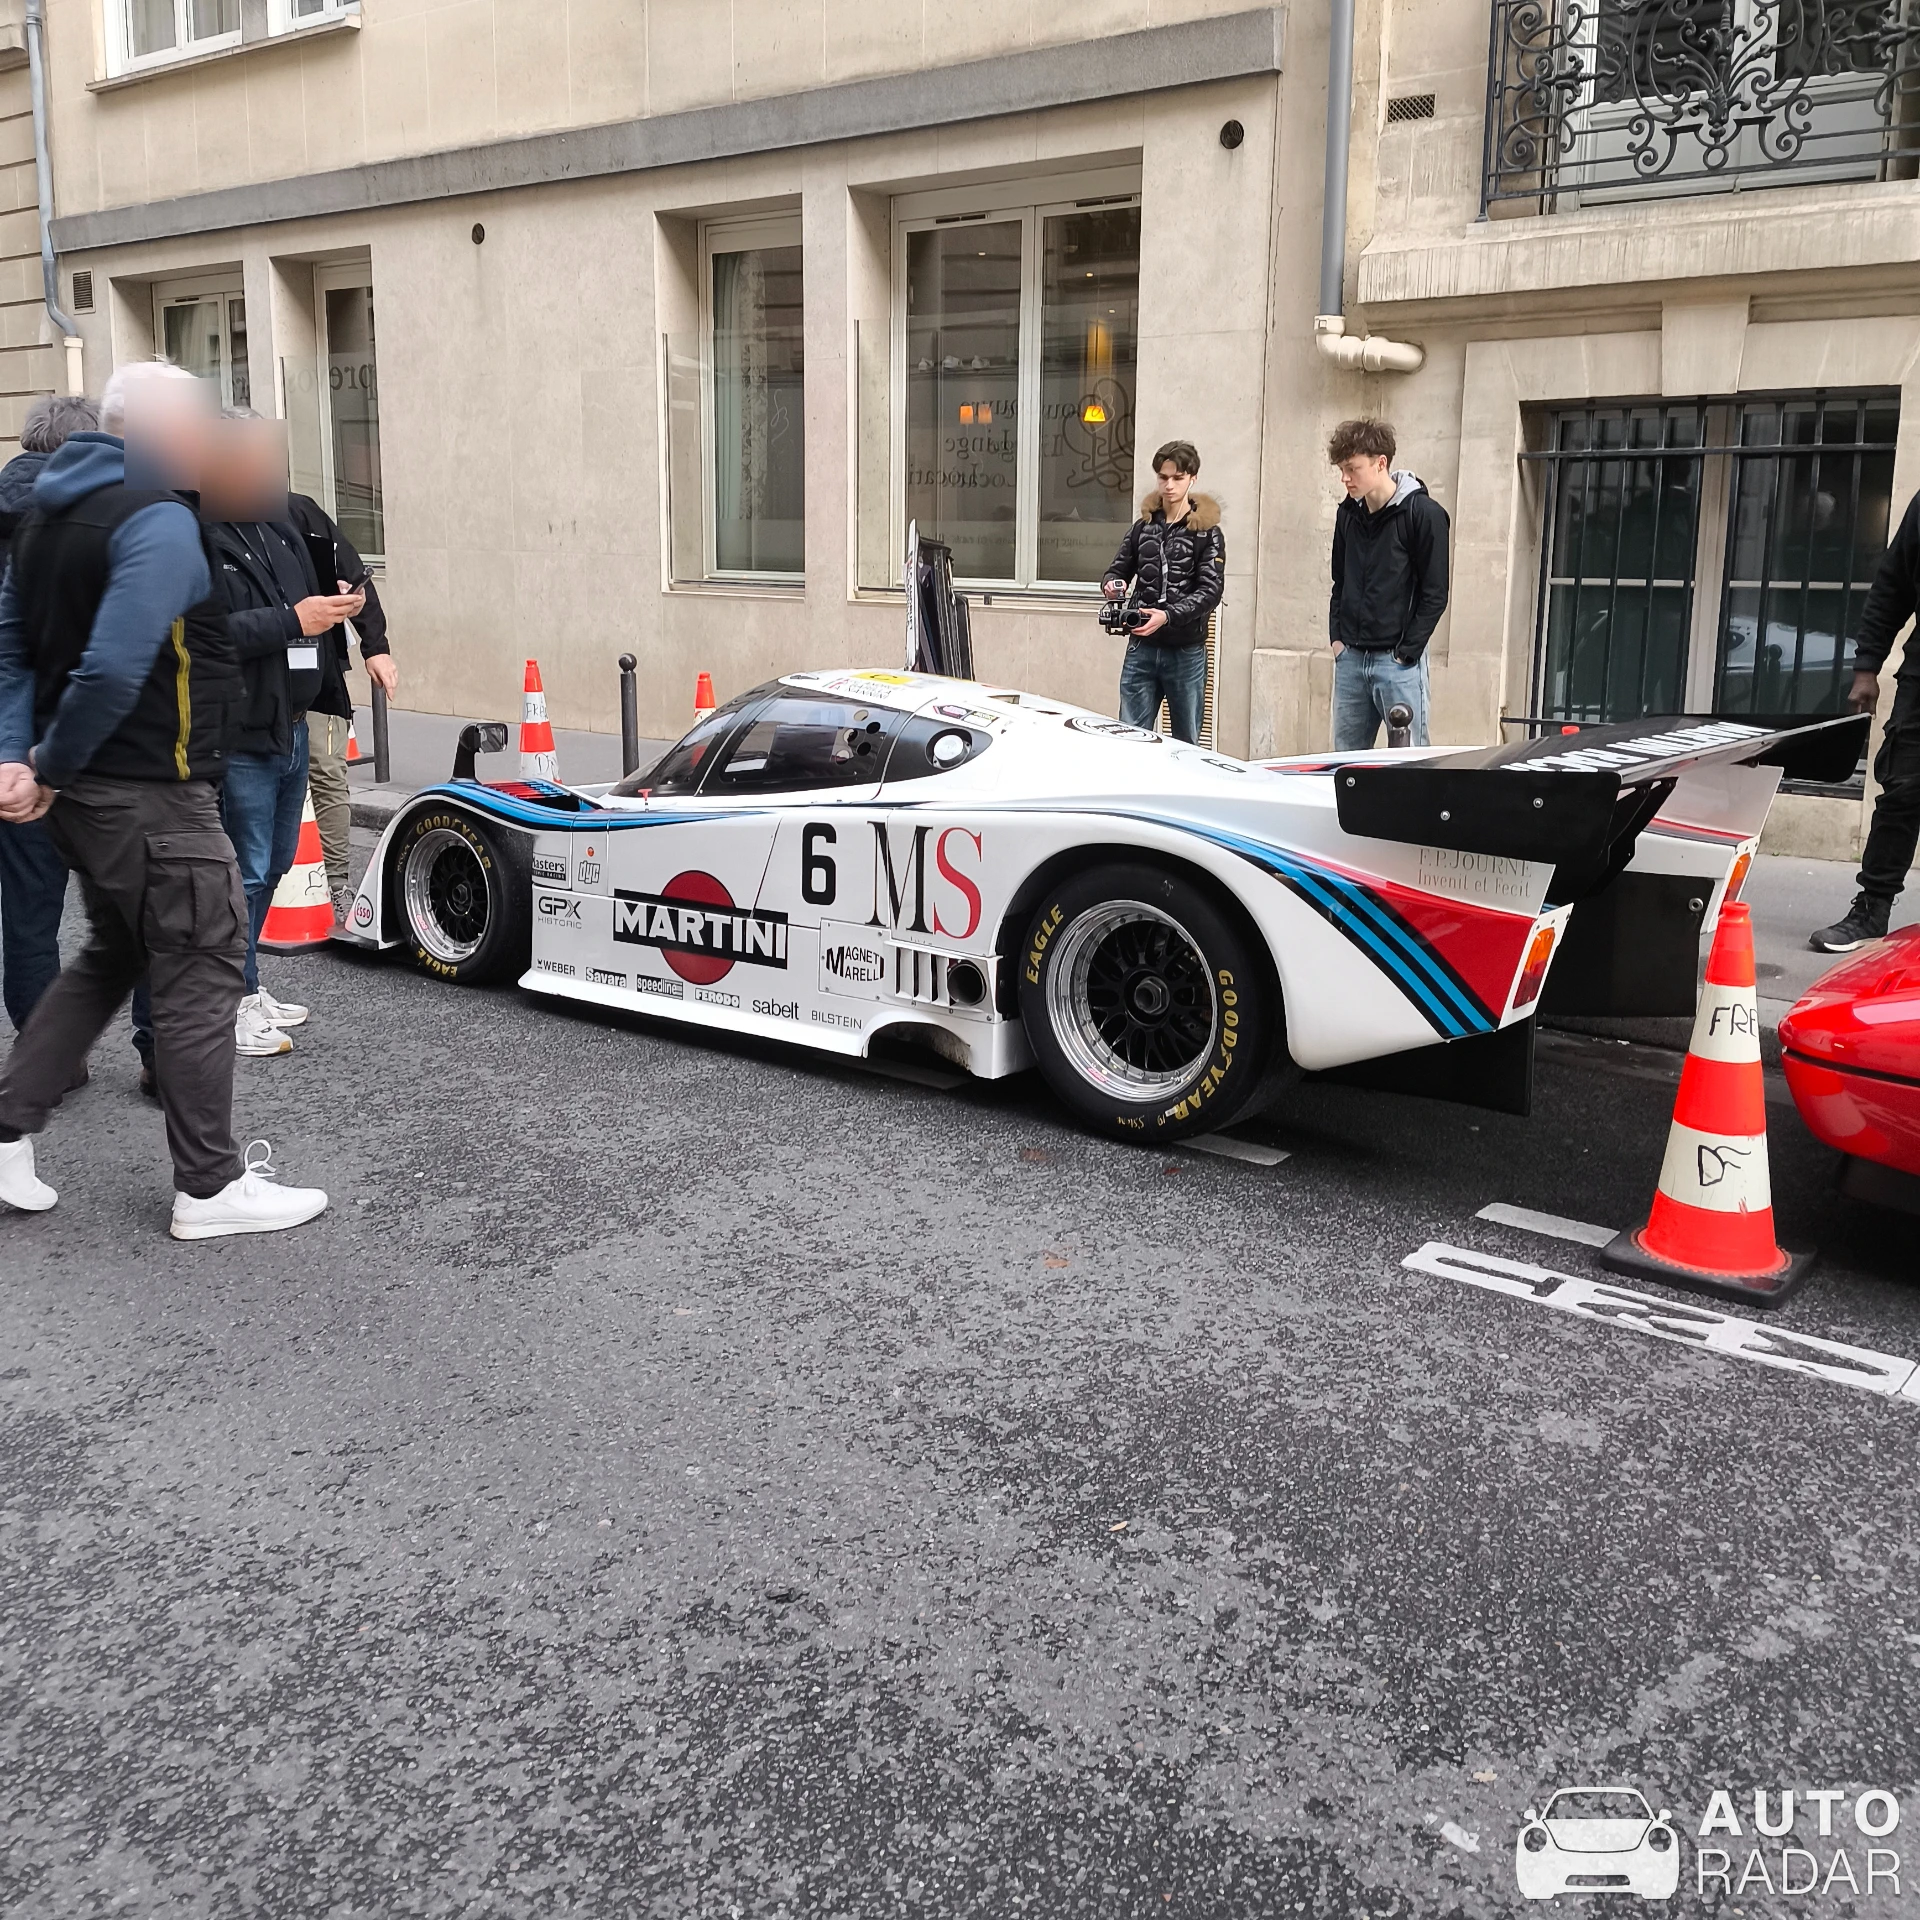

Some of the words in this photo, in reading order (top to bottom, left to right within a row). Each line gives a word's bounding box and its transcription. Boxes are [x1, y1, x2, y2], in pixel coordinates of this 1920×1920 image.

[802, 822, 837, 905] 6
[865, 821, 982, 940] MS
[1474, 876, 1488, 893] et
[538, 896, 582, 920] GPX
[537, 916, 583, 930] HISTORIC
[614, 899, 787, 960] MARTINI
[1026, 904, 1064, 985] EAGLE
[416, 946, 459, 978] EAGLE
[543, 960, 576, 976] WEBER
[585, 967, 627, 988] Savara
[637, 976, 679, 997] speedline
[695, 988, 740, 1008] FERODO
[752, 998, 799, 1020] sabelt
[811, 1010, 863, 1029] BILSTEIN
[1175, 969, 1240, 1121] GOODYEAR
